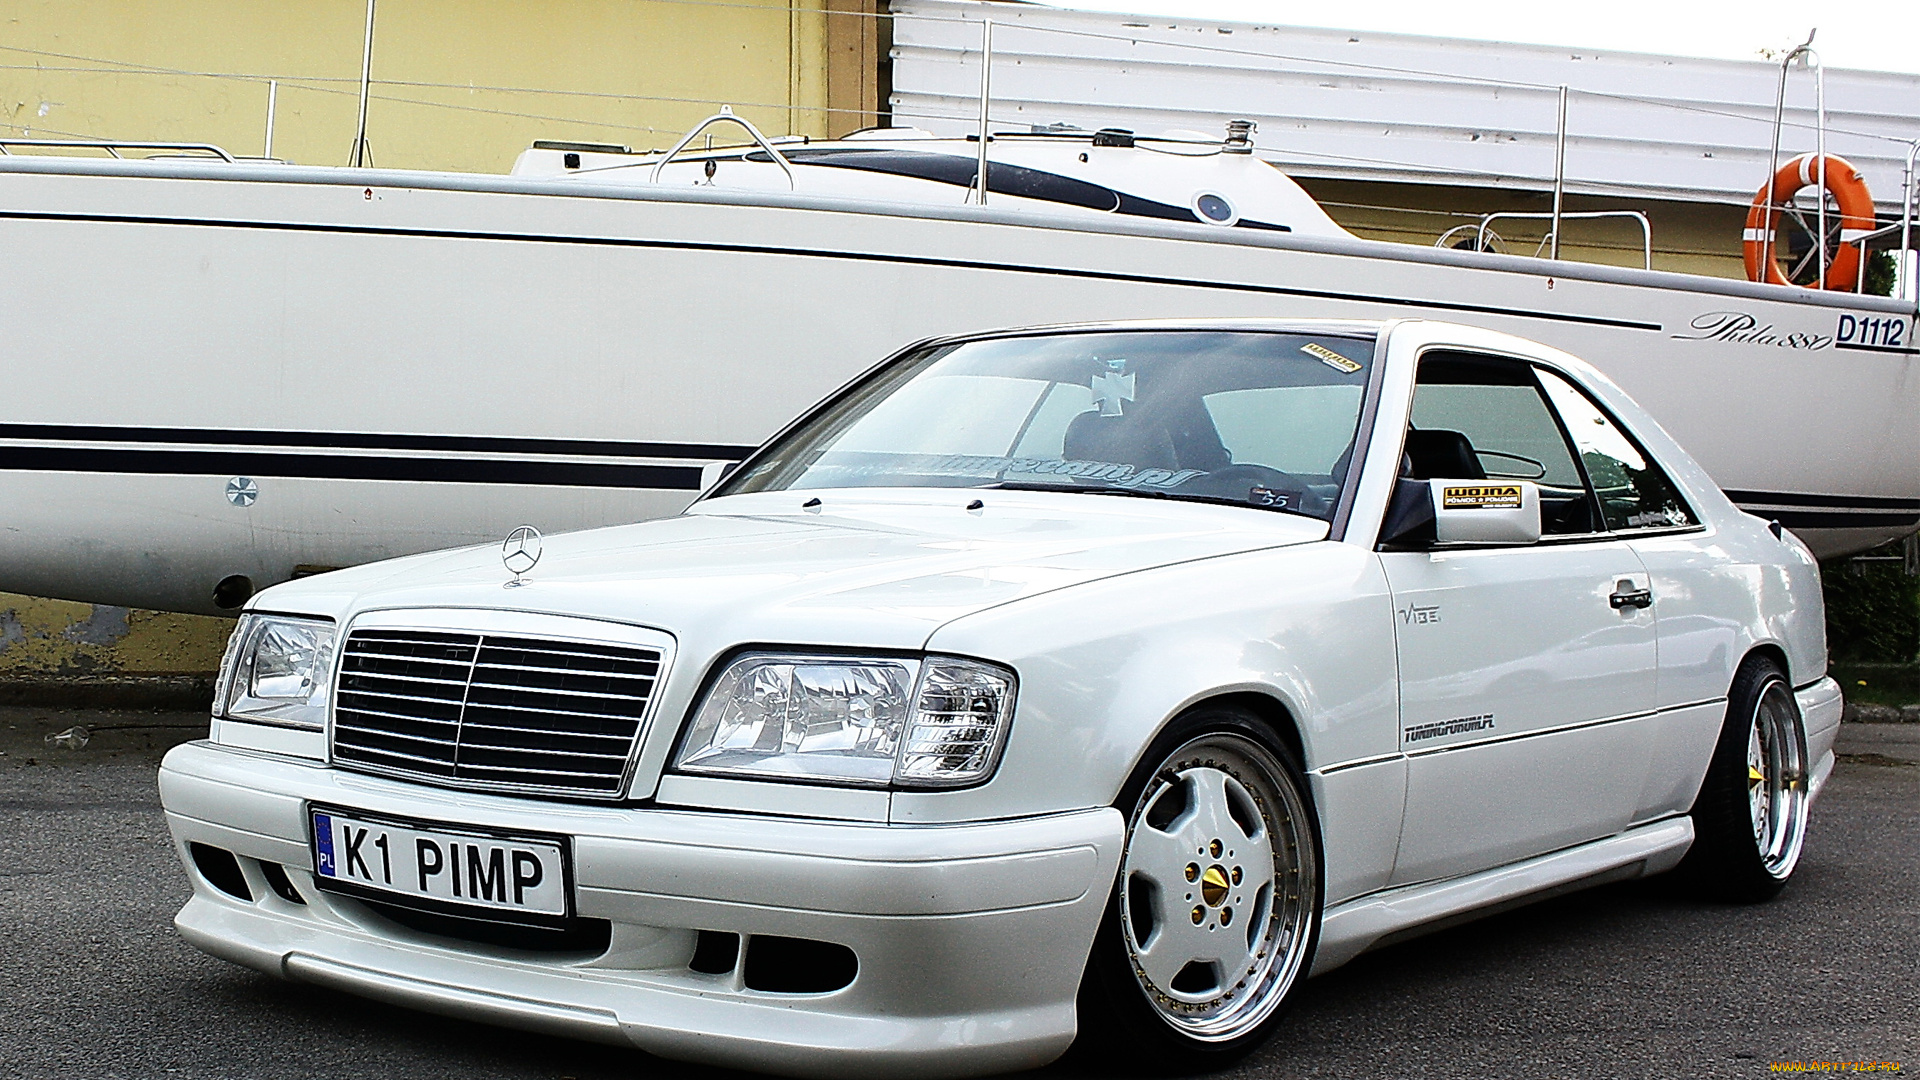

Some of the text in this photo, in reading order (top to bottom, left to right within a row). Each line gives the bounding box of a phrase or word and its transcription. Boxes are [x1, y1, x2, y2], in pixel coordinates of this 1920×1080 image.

[1671, 311, 1777, 345] Phila
[1837, 314, 1905, 346] D1112
[320, 853, 335, 869] PL
[343, 825, 544, 905] K1 PIMP
